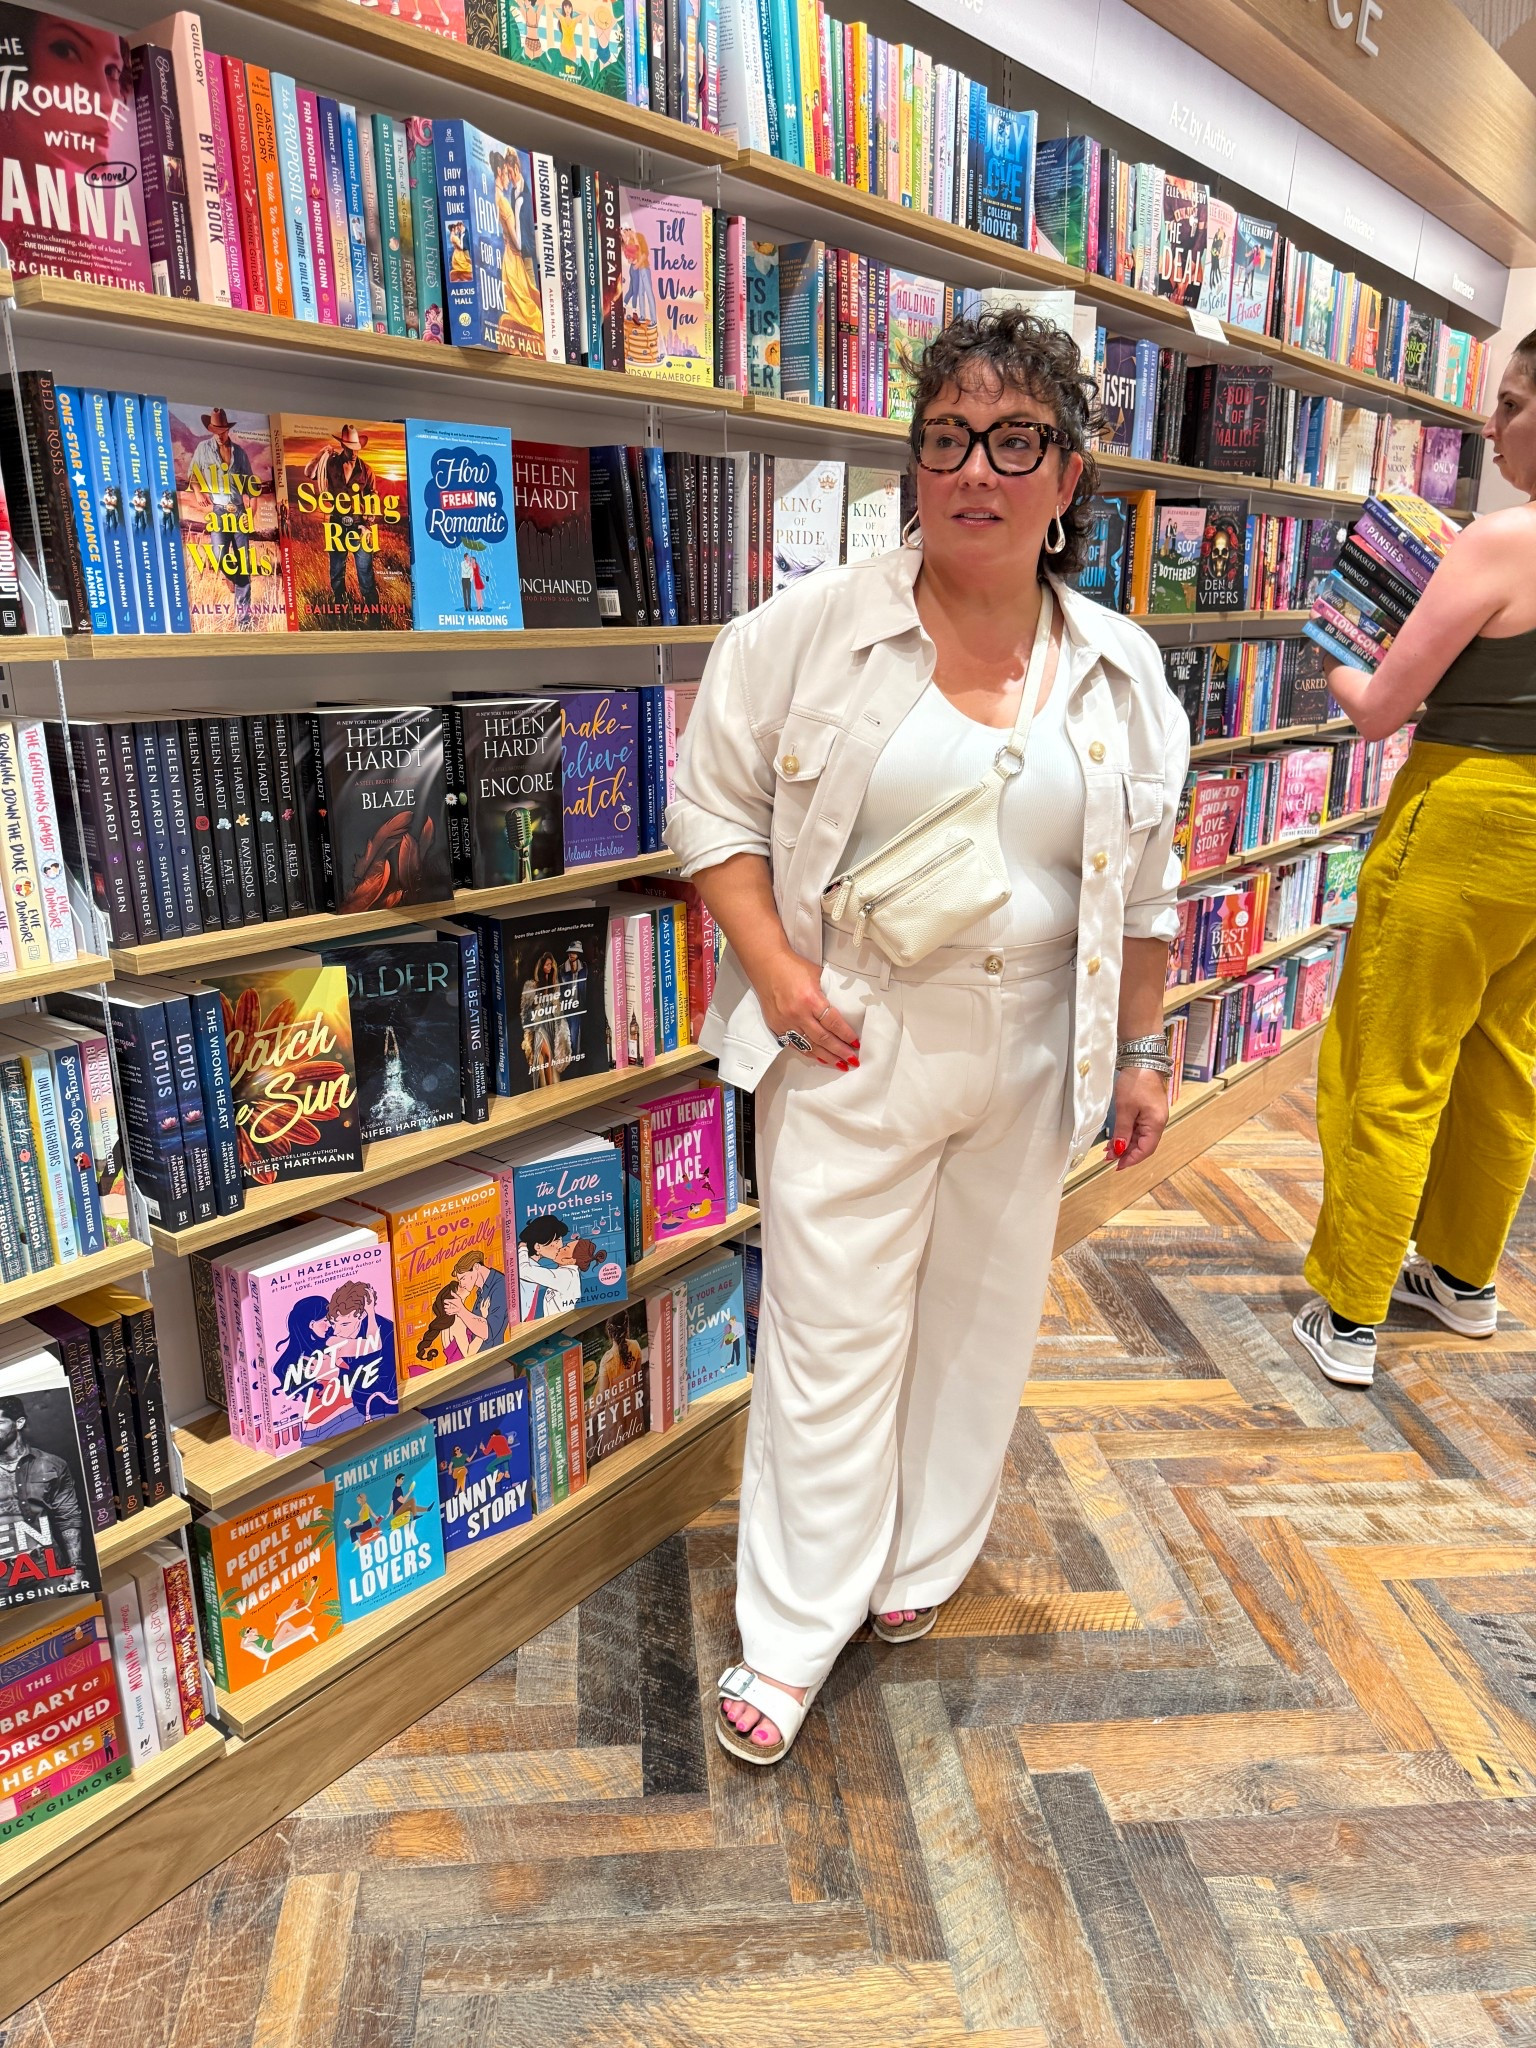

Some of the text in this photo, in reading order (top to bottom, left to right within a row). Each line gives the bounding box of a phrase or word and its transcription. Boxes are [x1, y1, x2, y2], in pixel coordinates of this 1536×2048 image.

[190, 22, 205, 87] GUILLORY
[0, 63, 130, 132] TROUBLE
[302, 99, 318, 182] FAN FAVORITE
[1170, 111, 1237, 159] A-Z by Author
[90, 165, 130, 182] a novel
[326, 111, 343, 227] summer at firefly beach
[2, 157, 142, 248] ANNA
[199, 132, 224, 244] BY THE BOOK
[537, 159, 555, 279] HUSBAND MATERIAL
[560, 173, 573, 282] GLITTERLAND
[980, 216, 1018, 240] HOOVER
[987, 206, 1012, 220] COLLEEN
[1343, 208, 1375, 241] Romance
[312, 200, 328, 290] ADRIENNE GUNN
[604, 189, 615, 287] FOR REAL
[656, 218, 685, 246] Till
[1165, 220, 1181, 244] THE
[294, 218, 311, 305] JASMINE GUILLORY
[651, 248, 698, 272] There
[1161, 246, 1201, 287] DEAL
[658, 277, 698, 301] Was
[1452, 273, 1475, 300] Romance
[896, 289, 935, 316] HOLDING
[667, 304, 698, 334] You
[907, 318, 933, 340] REINS
[1227, 386, 1253, 404] GOD
[1232, 410, 1244, 424] OF
[1216, 430, 1259, 446] MALICE
[59, 392, 100, 563] ONE-STAR ROMANCE
[185, 463, 263, 497] Alive
[435, 458, 490, 489] How
[516, 464, 575, 487] HELEN
[1388, 464, 1407, 473] MOON
[1433, 462, 1454, 474] ONLY
[297, 480, 402, 525] Seeing
[442, 491, 497, 507] FREAKING
[515, 488, 579, 510] HARDT
[780, 498, 822, 513] KING
[853, 504, 887, 518] KING
[205, 509, 256, 534] and
[429, 509, 505, 544] Romantic
[866, 522, 875, 530] OF
[322, 525, 381, 554] Red
[776, 531, 825, 546] PRIDE
[852, 534, 888, 548] ENVY
[1177, 541, 1198, 553] SCOT
[1367, 526, 1404, 563] PANSIES
[186, 542, 274, 577] Wells
[1159, 564, 1197, 581] BOTHERED
[1346, 544, 1408, 598] UNMASKED HELEN
[85, 566, 98, 609] HANKIN
[94, 570, 106, 606] LAURA
[1199, 591, 1239, 605] VIPERS
[1205, 579, 1233, 591] DEN of
[1339, 559, 1399, 613] UNHINGED HELEN
[304, 603, 407, 615] BAILEY HANNAH
[439, 615, 508, 626] EMILY HARDING
[347, 726, 421, 749] HELEN
[484, 717, 545, 738] HELEN
[346, 748, 425, 772] HARDT
[483, 736, 548, 759] HARDT
[24, 728, 56, 853] THE GENTLEMAN'S GAMBIT
[361, 789, 416, 810] BLAZE
[480, 773, 554, 798] ENCORE
[1200, 786, 1240, 801] HOW TO
[1201, 801, 1227, 818] END A
[96, 738, 110, 785] HELEN
[103, 792, 118, 841] HARDT
[115, 878, 126, 913] BURN
[1200, 817, 1226, 834] LOVE
[1196, 833, 1229, 853] STORY
[1210, 942, 1245, 960] MAN
[1212, 927, 1248, 944] BEST
[531, 999, 580, 1021] your life
[534, 985, 577, 1007] time of
[86, 1046, 101, 1104] BUSINESS
[98, 1048, 112, 1096] WHISKY
[206, 1007, 229, 1130] THE WRONG HEART
[250, 1073, 358, 1144] Sun
[249, 1148, 338, 1166] TODAY BESTSELLING AUTHOR
[653, 1130, 703, 1162] HAPPY
[536, 1171, 601, 1198] the Love
[655, 1154, 704, 1191] PLACE
[80, 1172, 94, 1233] ELLIOT FLETCHER
[398, 1187, 497, 1226] ALI HAZELWOOD
[526, 1191, 613, 1217] Hypothesis
[426, 1217, 474, 1240] Love,
[400, 1218, 496, 1281] Theoretically
[270, 1249, 382, 1287] ALI HAZELWOOD
[68, 1342, 84, 1405] CREATURES
[79, 1343, 95, 1396] RUTHLESS
[284, 1332, 382, 1390] NOT IN
[303, 1357, 383, 1421] LOVE
[584, 1391, 645, 1438] HEYER
[586, 1419, 645, 1462] Arabella
[89, 1443, 104, 1502] GEISSINGER
[468, 1480, 528, 1539] STORY
[226, 1506, 323, 1577] PEOPLE WE
[359, 1523, 420, 1572] BOOK
[241, 1535, 313, 1591] MEET ON
[351, 1544, 433, 1605] LOVERS
[236, 1548, 322, 1616] VACATION
[26, 1674, 53, 1694] THE
[3, 1735, 95, 1793] HEARTS
[47, 1766, 122, 1813] GILMORE
